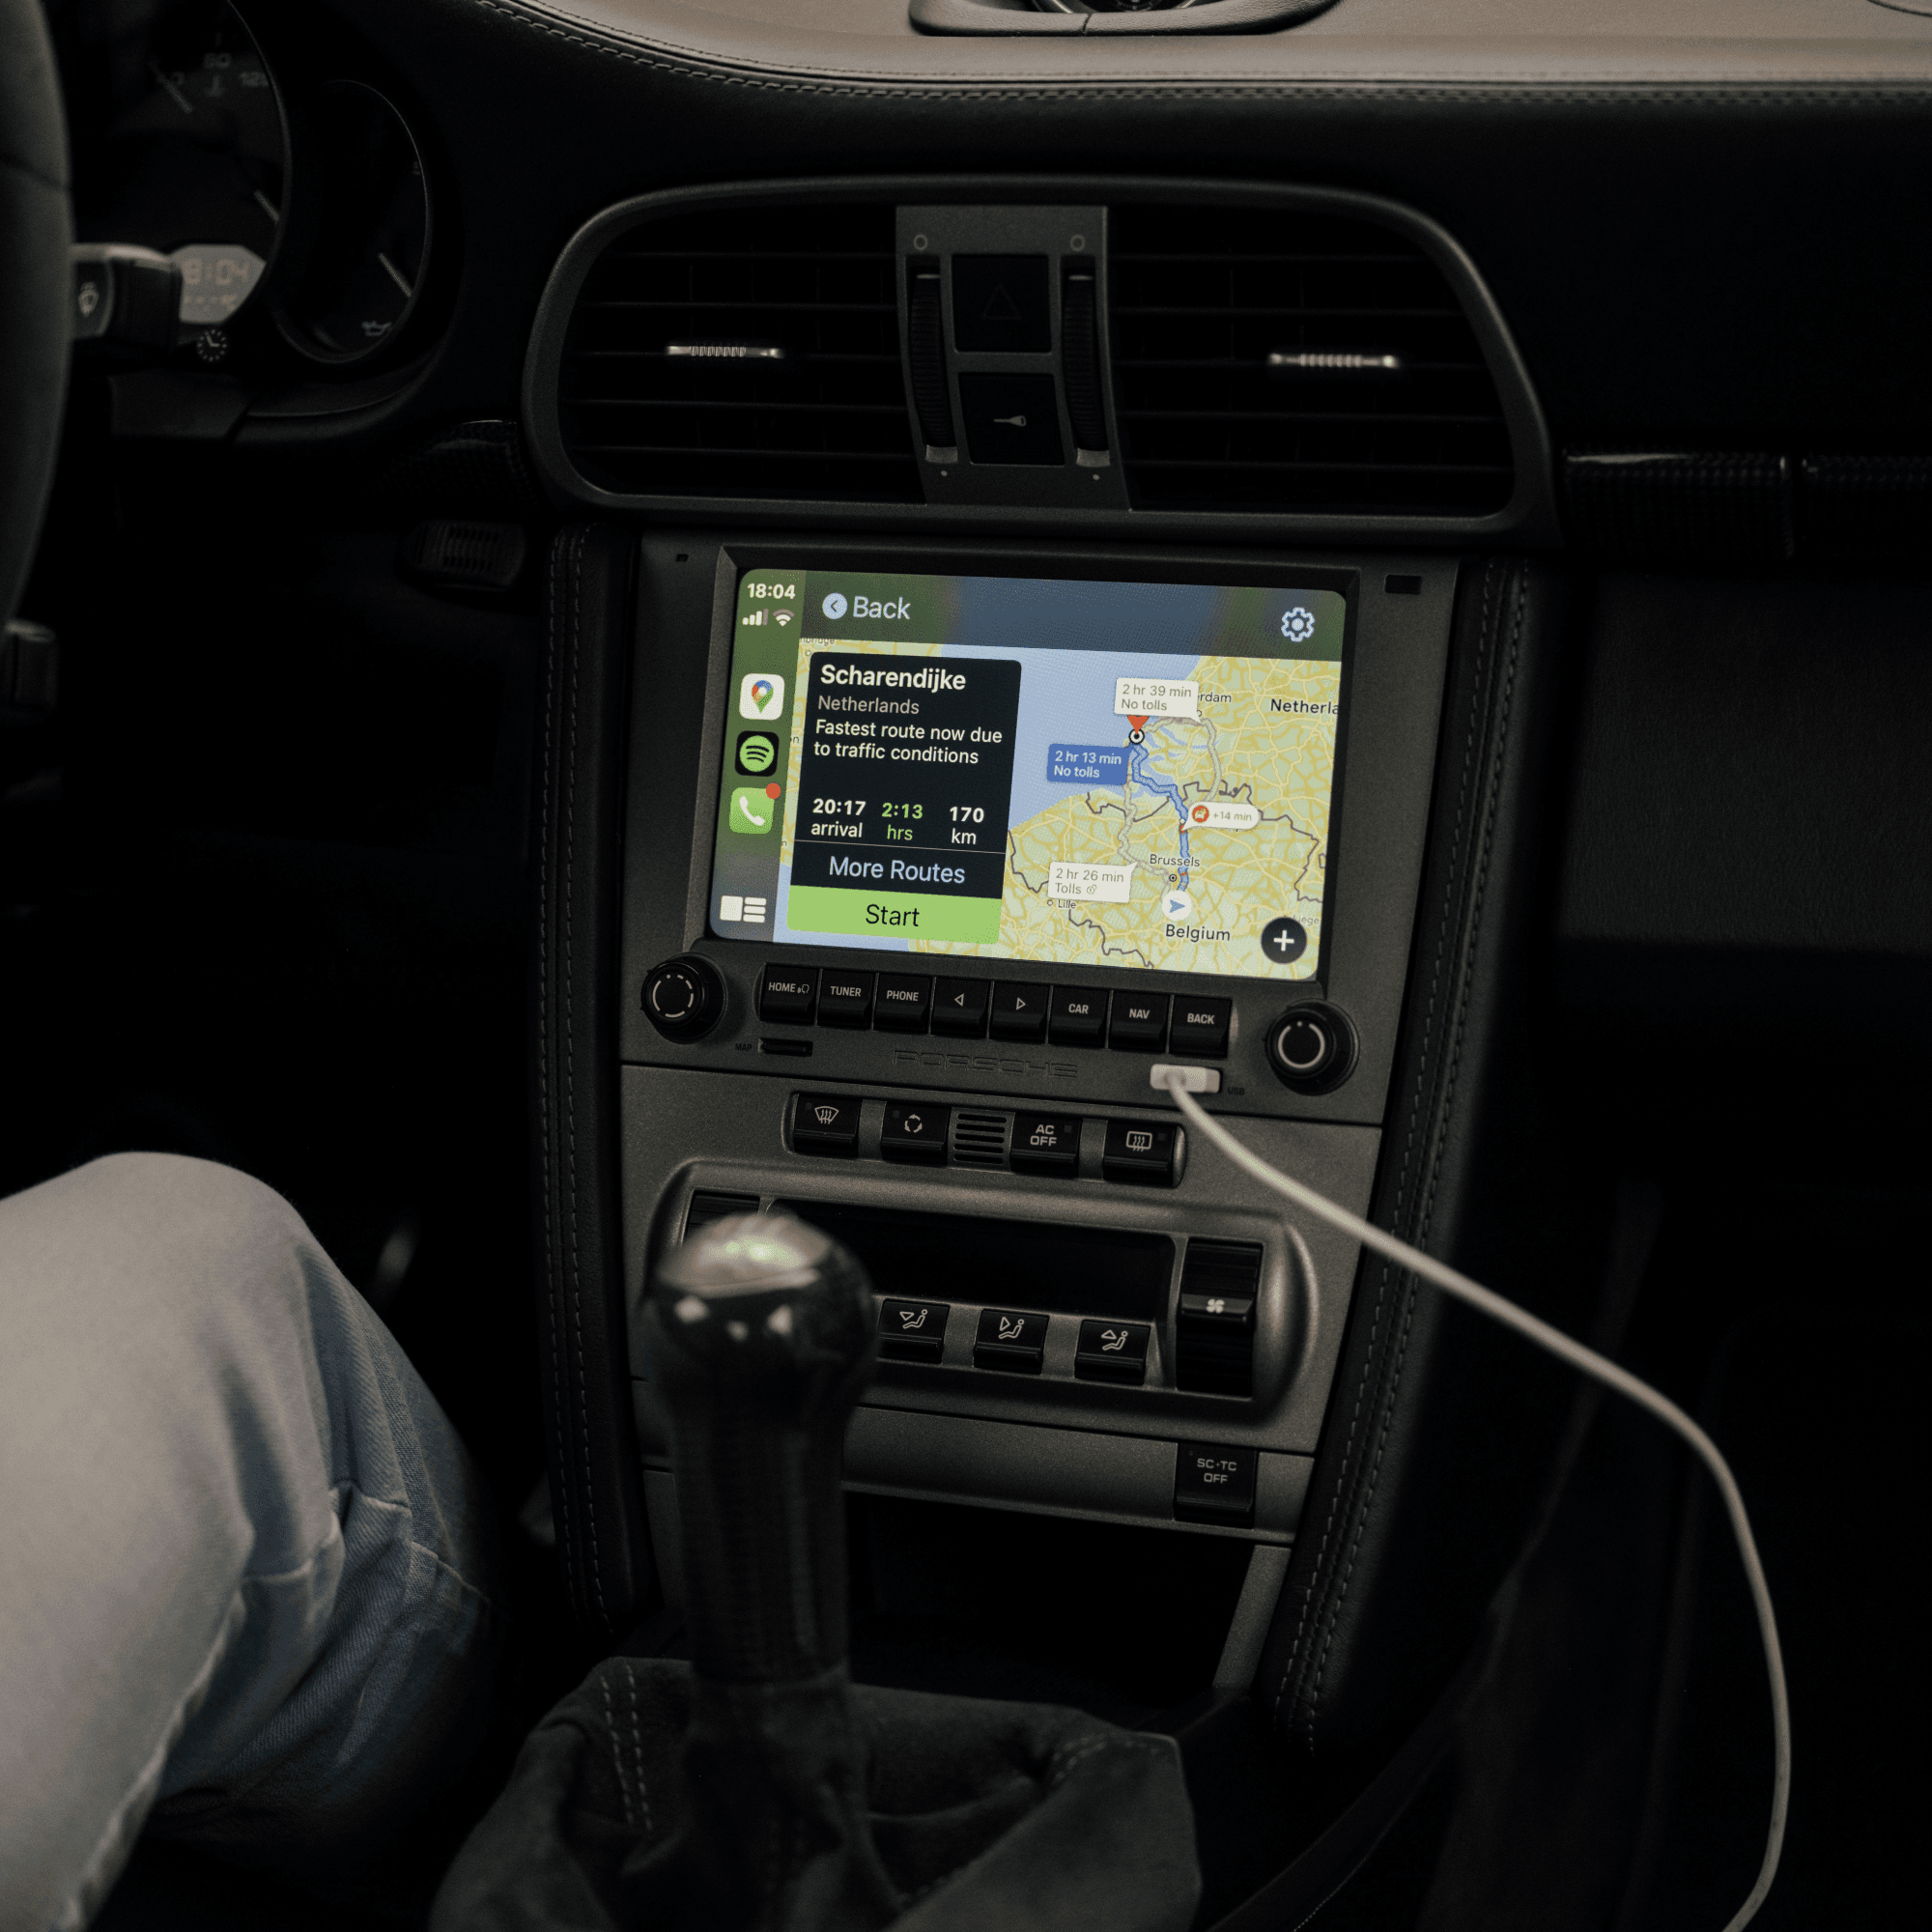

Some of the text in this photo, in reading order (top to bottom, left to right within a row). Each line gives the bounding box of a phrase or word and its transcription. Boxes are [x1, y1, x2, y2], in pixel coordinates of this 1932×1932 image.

[747, 582, 796, 600] 18:04
[853, 595, 911, 620] Back
[820, 664, 967, 694] Scharendijke
[1122, 684, 1192, 697] 2 hr 39 min
[1198, 692, 1232, 703] rdam
[817, 695, 920, 715] Netherlands
[1121, 698, 1168, 711] No tolls
[815, 719, 1003, 744] Fastest route now due
[813, 741, 980, 764] to traffic conditions
[1054, 750, 1122, 764] 2 hr 13 min
[1053, 765, 1100, 778] No tolls
[812, 798, 867, 816] 20:17
[881, 802, 923, 820] 2:13
[949, 806, 985, 823] 170
[1212, 810, 1253, 821] +14 min
[810, 822, 864, 838] arrival
[886, 824, 914, 840] hrs
[951, 828, 978, 845] km
[1150, 853, 1201, 867] Brussels
[829, 856, 966, 884] More Routes
[1055, 867, 1124, 883] 2 hr 26 min
[1055, 882, 1082, 895] Tolls
[865, 903, 921, 927] Start
[1165, 923, 1231, 943] Belgium
[768, 981, 797, 993] HOME
[830, 985, 862, 998] TUNER
[886, 989, 920, 1002] PHONE
[1067, 1003, 1090, 1014] CAR
[1128, 1008, 1151, 1020] NAV
[1186, 1012, 1215, 1025] BACK
[734, 1042, 753, 1052] MAP
[893, 1049, 1078, 1079] PORSCHE
[1227, 1087, 1245, 1096] USB
[1035, 1123, 1055, 1135] AC
[1030, 1135, 1058, 1147] OFF
[1203, 1472, 1229, 1484] OFF
